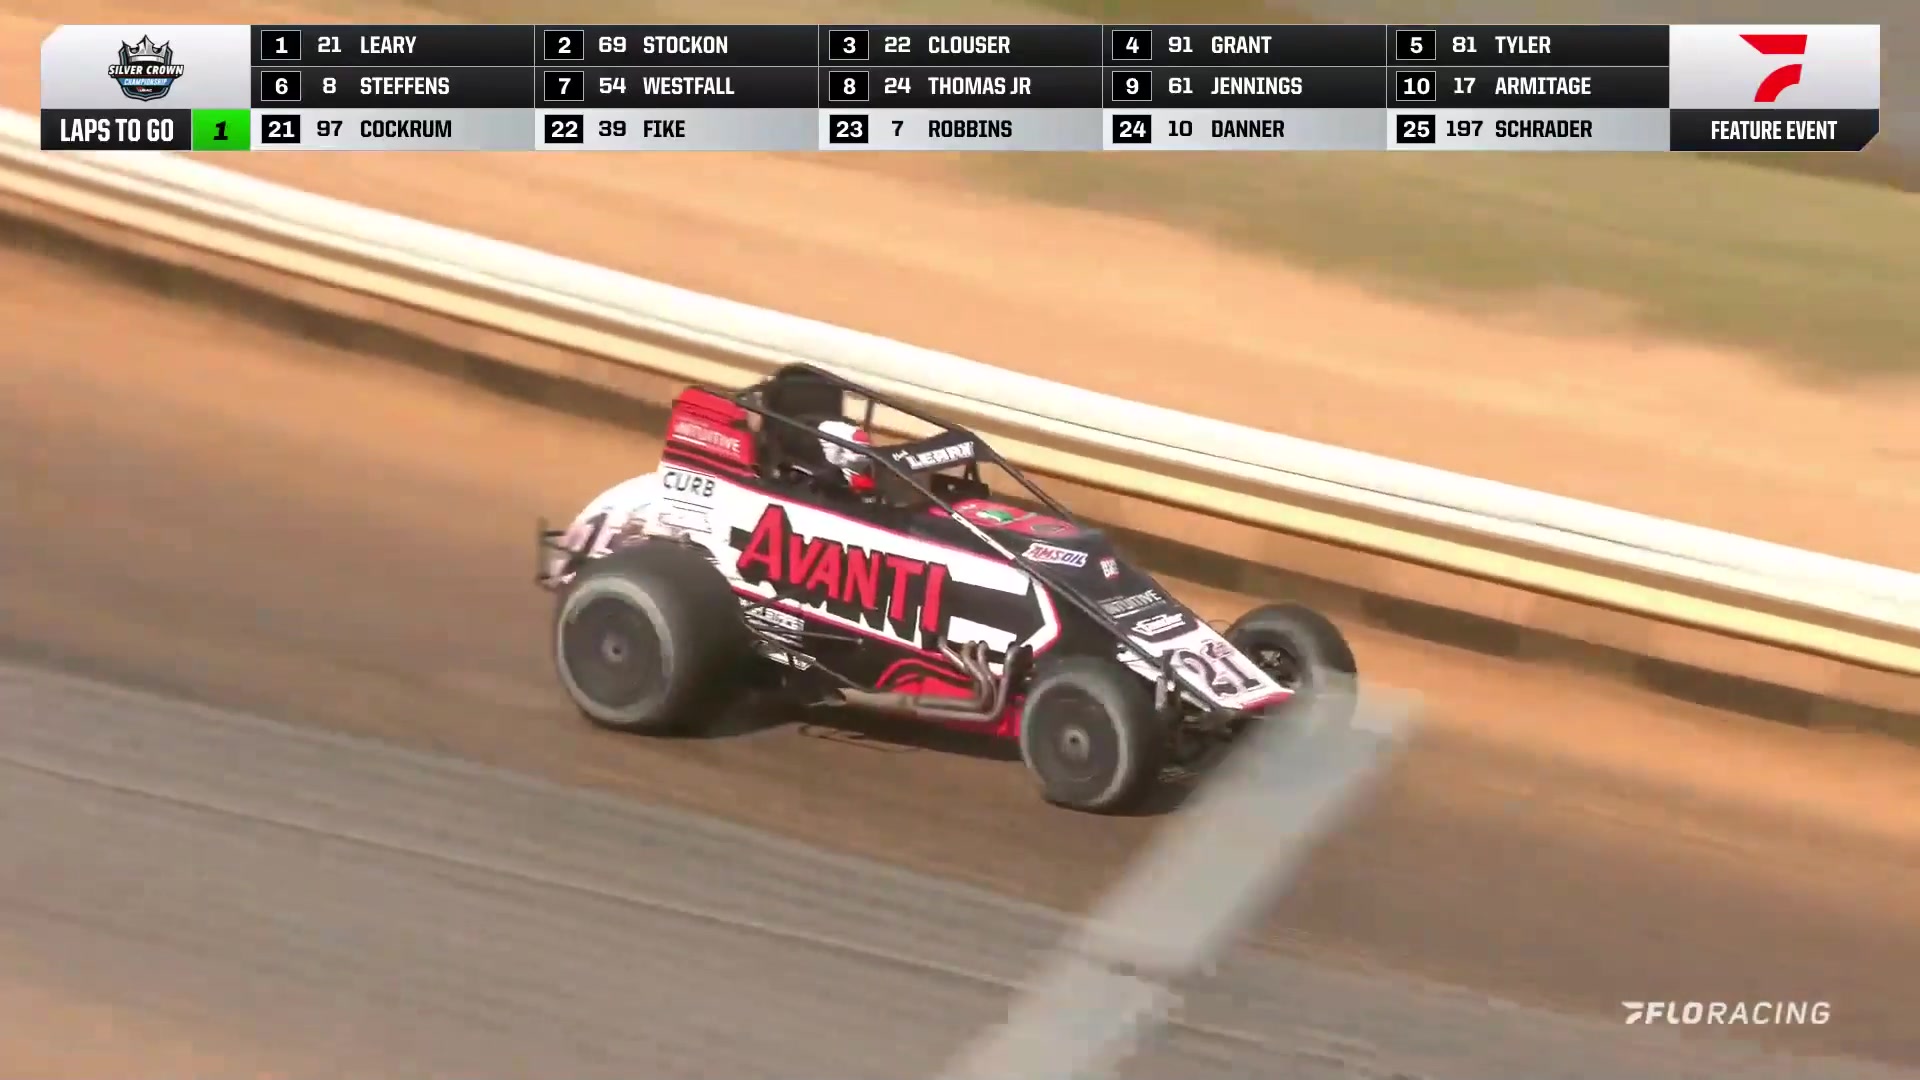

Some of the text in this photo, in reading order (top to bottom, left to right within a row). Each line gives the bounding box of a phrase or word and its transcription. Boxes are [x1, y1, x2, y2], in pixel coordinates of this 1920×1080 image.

[663, 471, 716, 497] CURB
[1028, 544, 1085, 566] AMSOIL
[1170, 640, 1263, 698] 21
